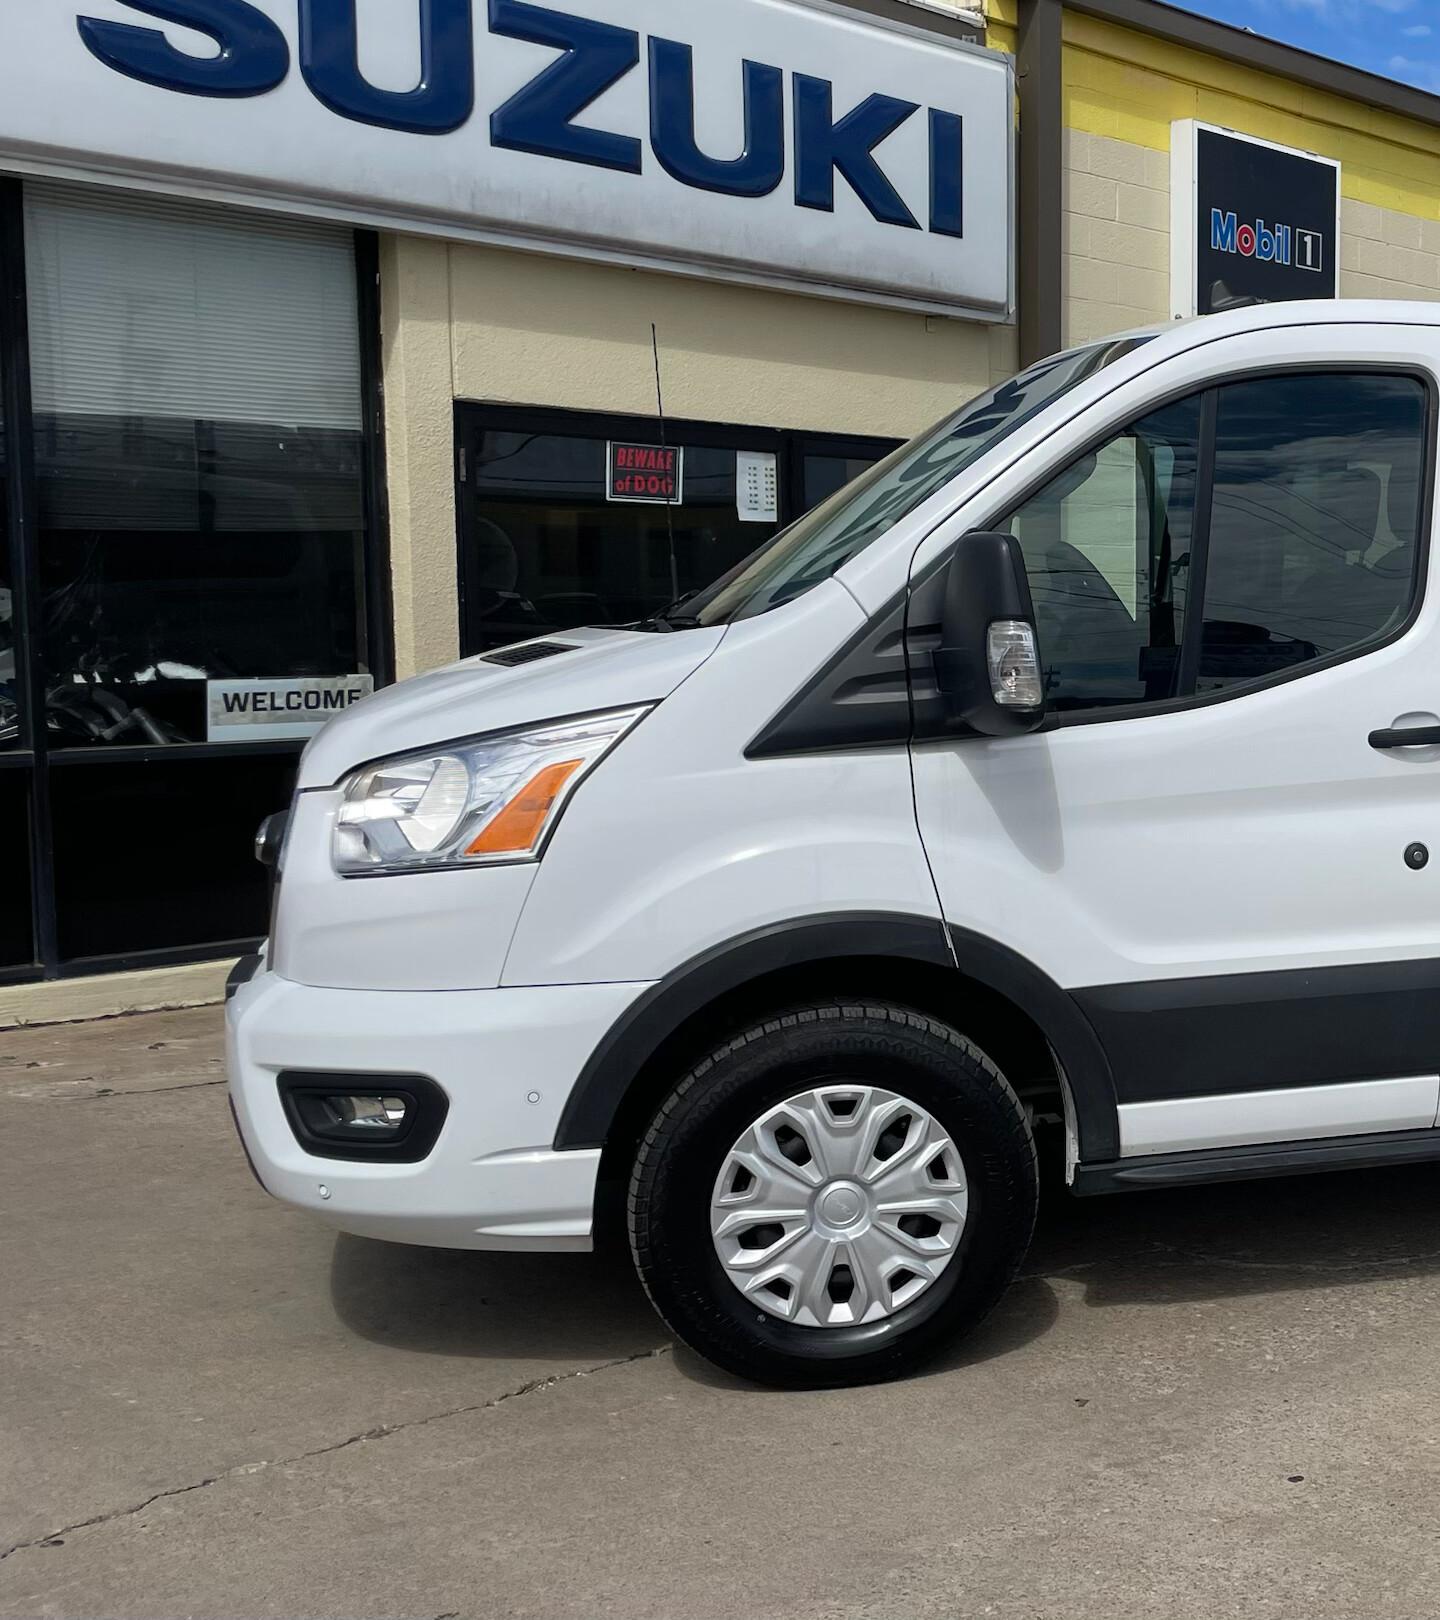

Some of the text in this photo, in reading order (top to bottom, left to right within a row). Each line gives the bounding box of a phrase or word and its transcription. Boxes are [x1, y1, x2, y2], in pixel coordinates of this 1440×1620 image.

[1211, 208, 1290, 265] Mobil
[617, 448, 673, 469] BEWARE
[615, 475, 673, 496] of DOG
